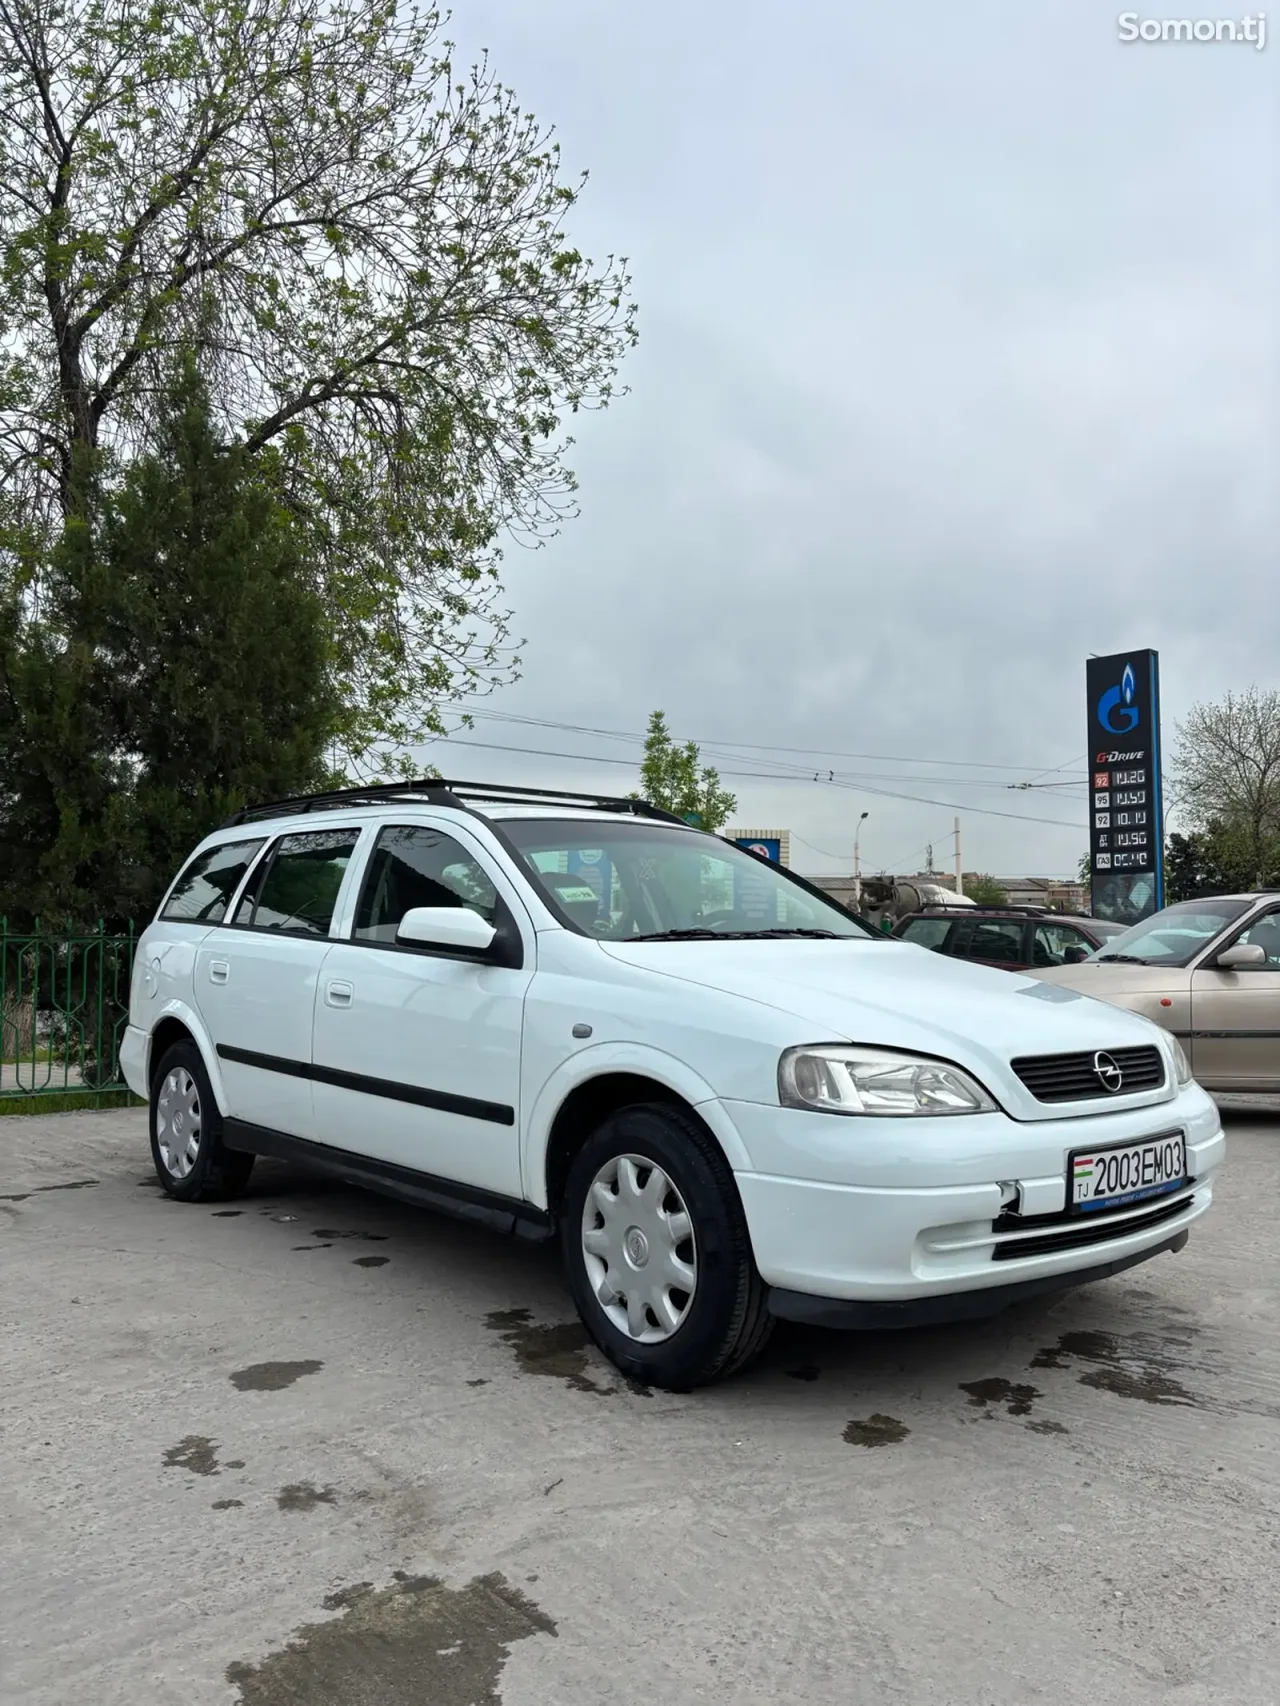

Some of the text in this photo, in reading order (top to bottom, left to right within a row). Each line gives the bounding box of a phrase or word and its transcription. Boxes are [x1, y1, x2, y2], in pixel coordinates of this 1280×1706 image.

[1096, 777, 1108, 787] 92
[1097, 795, 1108, 805] 95
[1097, 815, 1108, 825] 92
[1097, 856, 1110, 866] ГАЗ
[1093, 1141, 1181, 1197] 2003EM03
[1077, 1183, 1089, 1199] TJ
